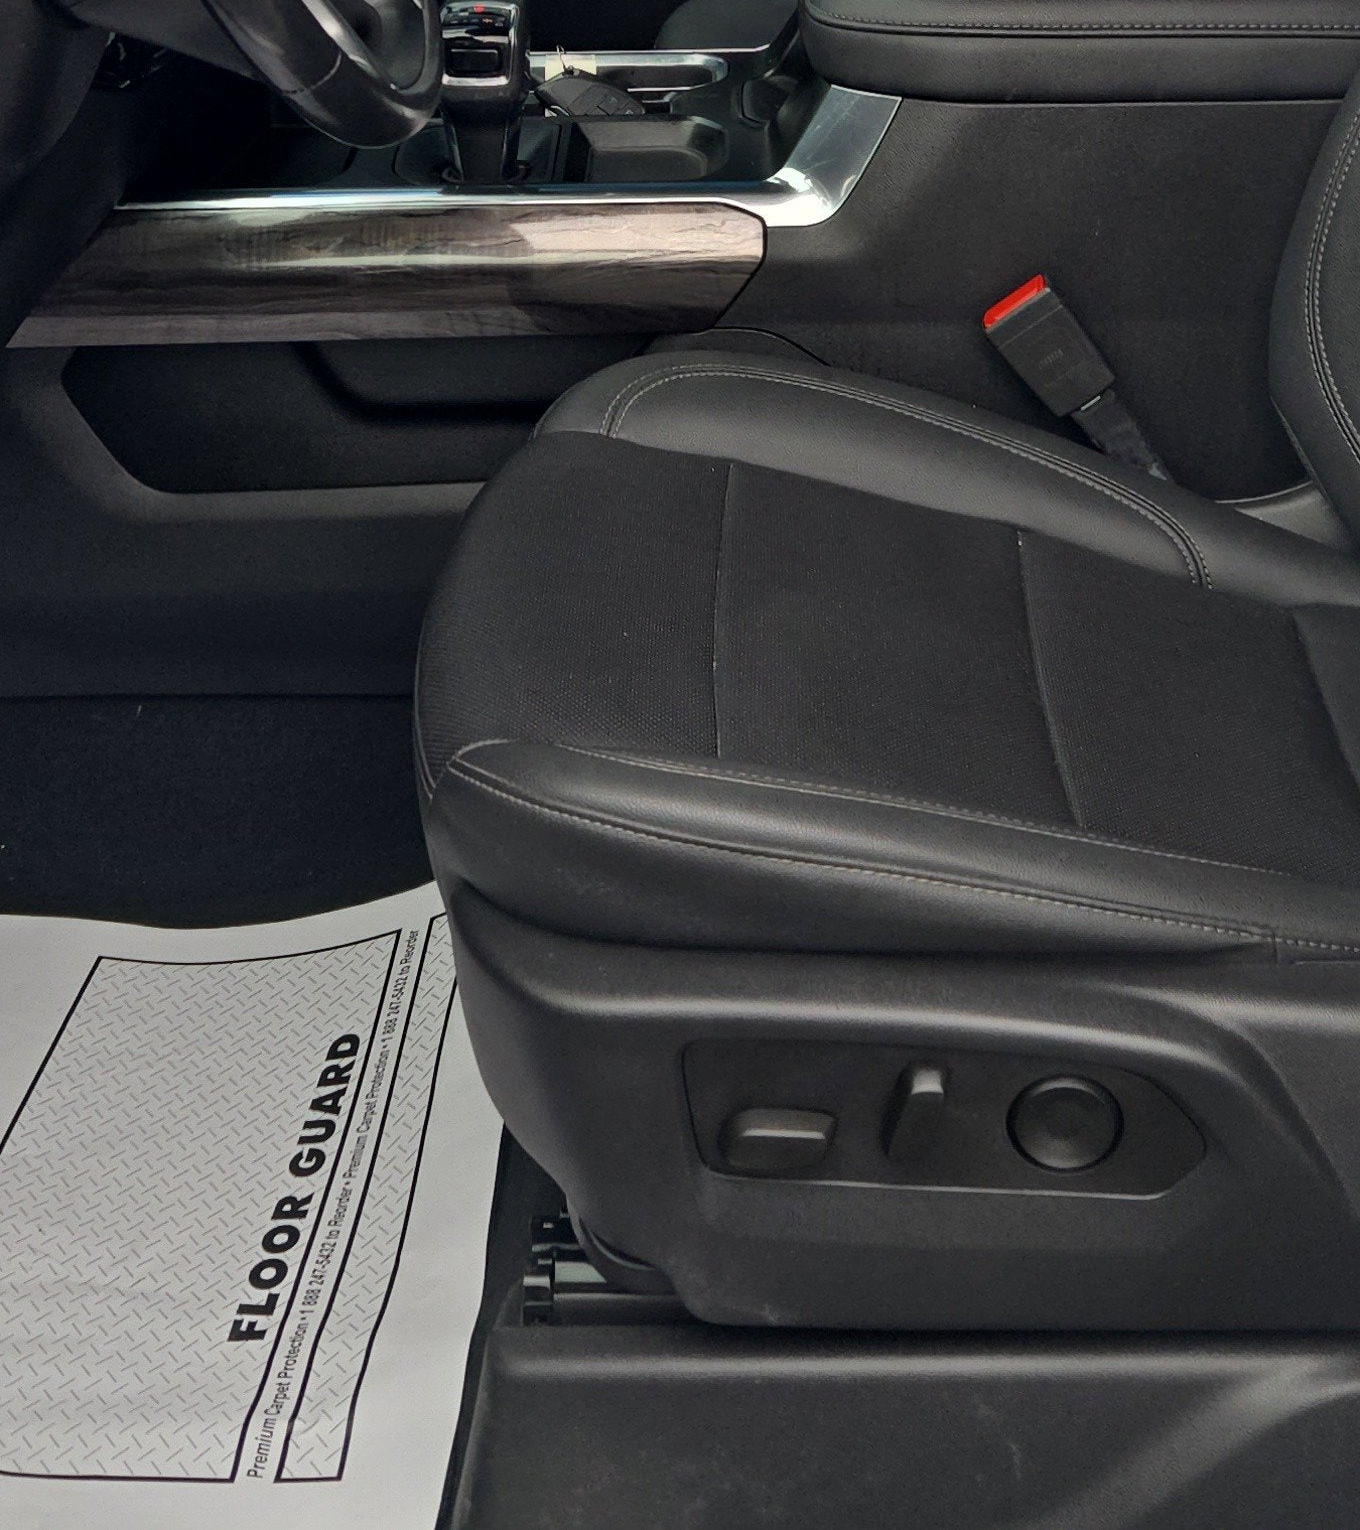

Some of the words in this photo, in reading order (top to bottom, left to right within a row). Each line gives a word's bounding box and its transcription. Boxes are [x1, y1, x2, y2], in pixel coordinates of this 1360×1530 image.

[399, 930, 420, 965] Reorder
[365, 1047, 390, 1100] Protection
[356, 1097, 378, 1134] Carpet
[342, 1134, 369, 1179] Premium
[227, 1192, 315, 1344] FLOOR
[288, 1033, 361, 1179] GUARD
[327, 1184, 353, 1227] Reorder
[326, 1227, 340, 1240] to
[309, 1240, 337, 1291] 247-5432
[302, 1289, 322, 1307] 888
[277, 1324, 310, 1379] Protection
[264, 1381, 291, 1416] Carpet
[246, 1414, 278, 1479] Premium
